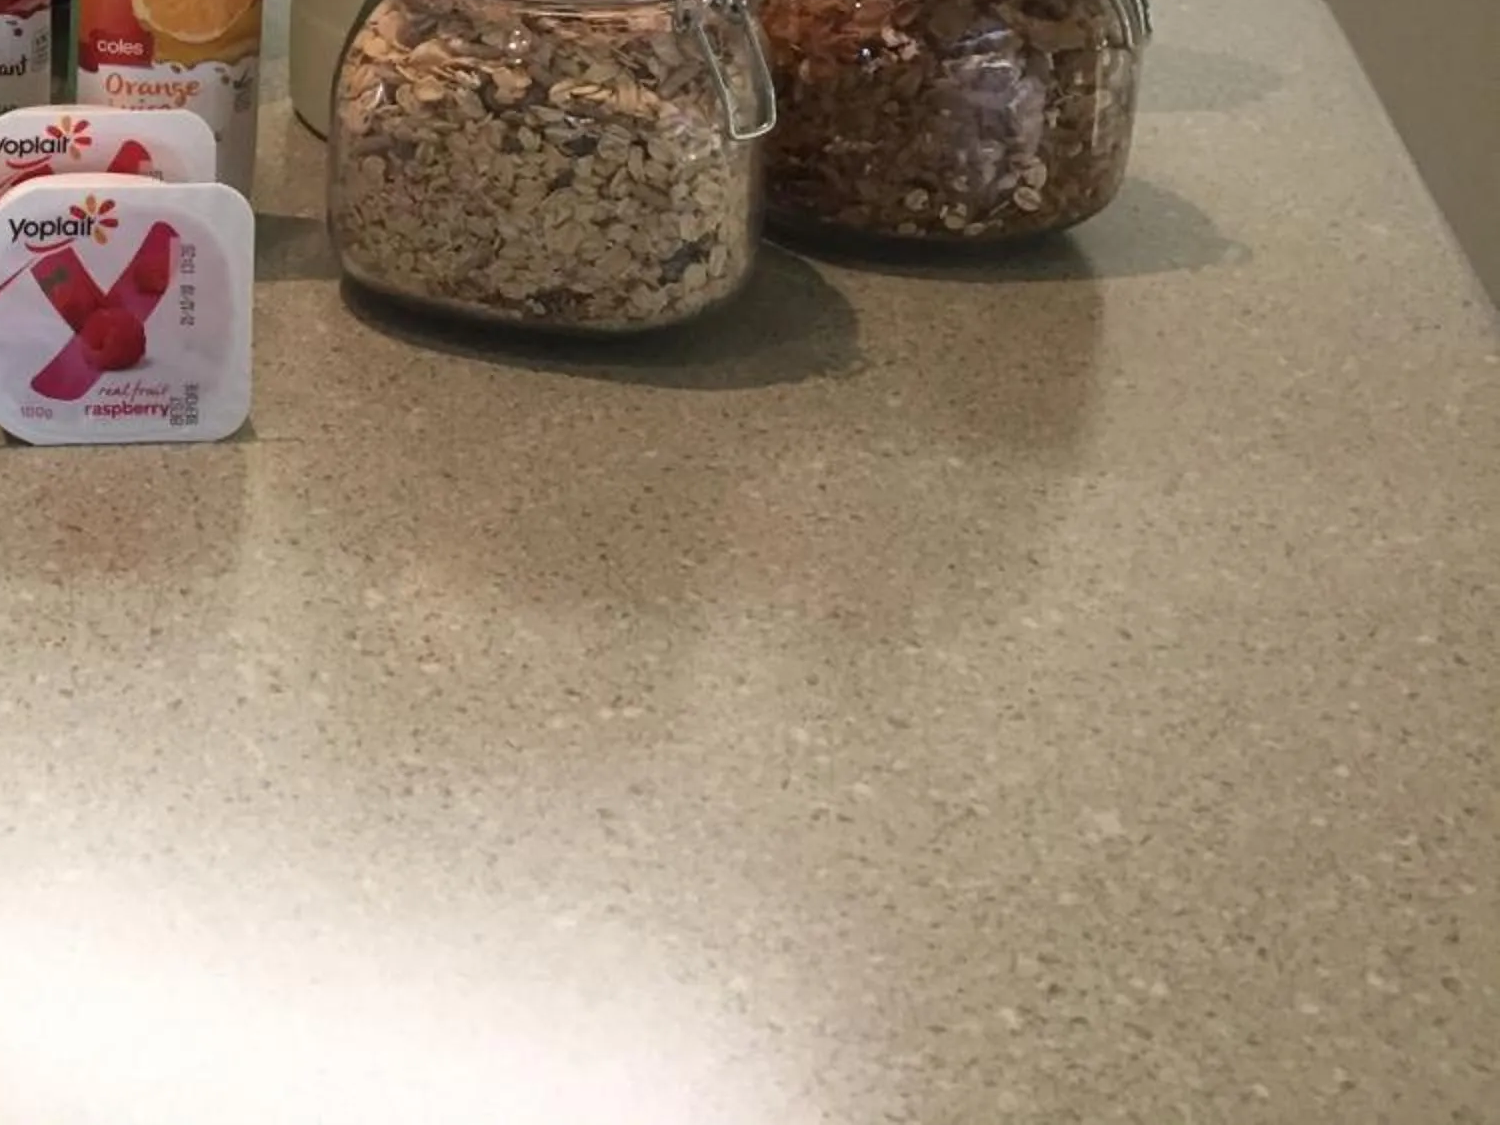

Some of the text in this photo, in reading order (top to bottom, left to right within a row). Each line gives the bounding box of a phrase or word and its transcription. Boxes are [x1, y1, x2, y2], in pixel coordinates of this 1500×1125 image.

[97, 38, 144, 56] coles
[105, 72, 200, 108] Orange
[84, 401, 170, 417] raspberry
